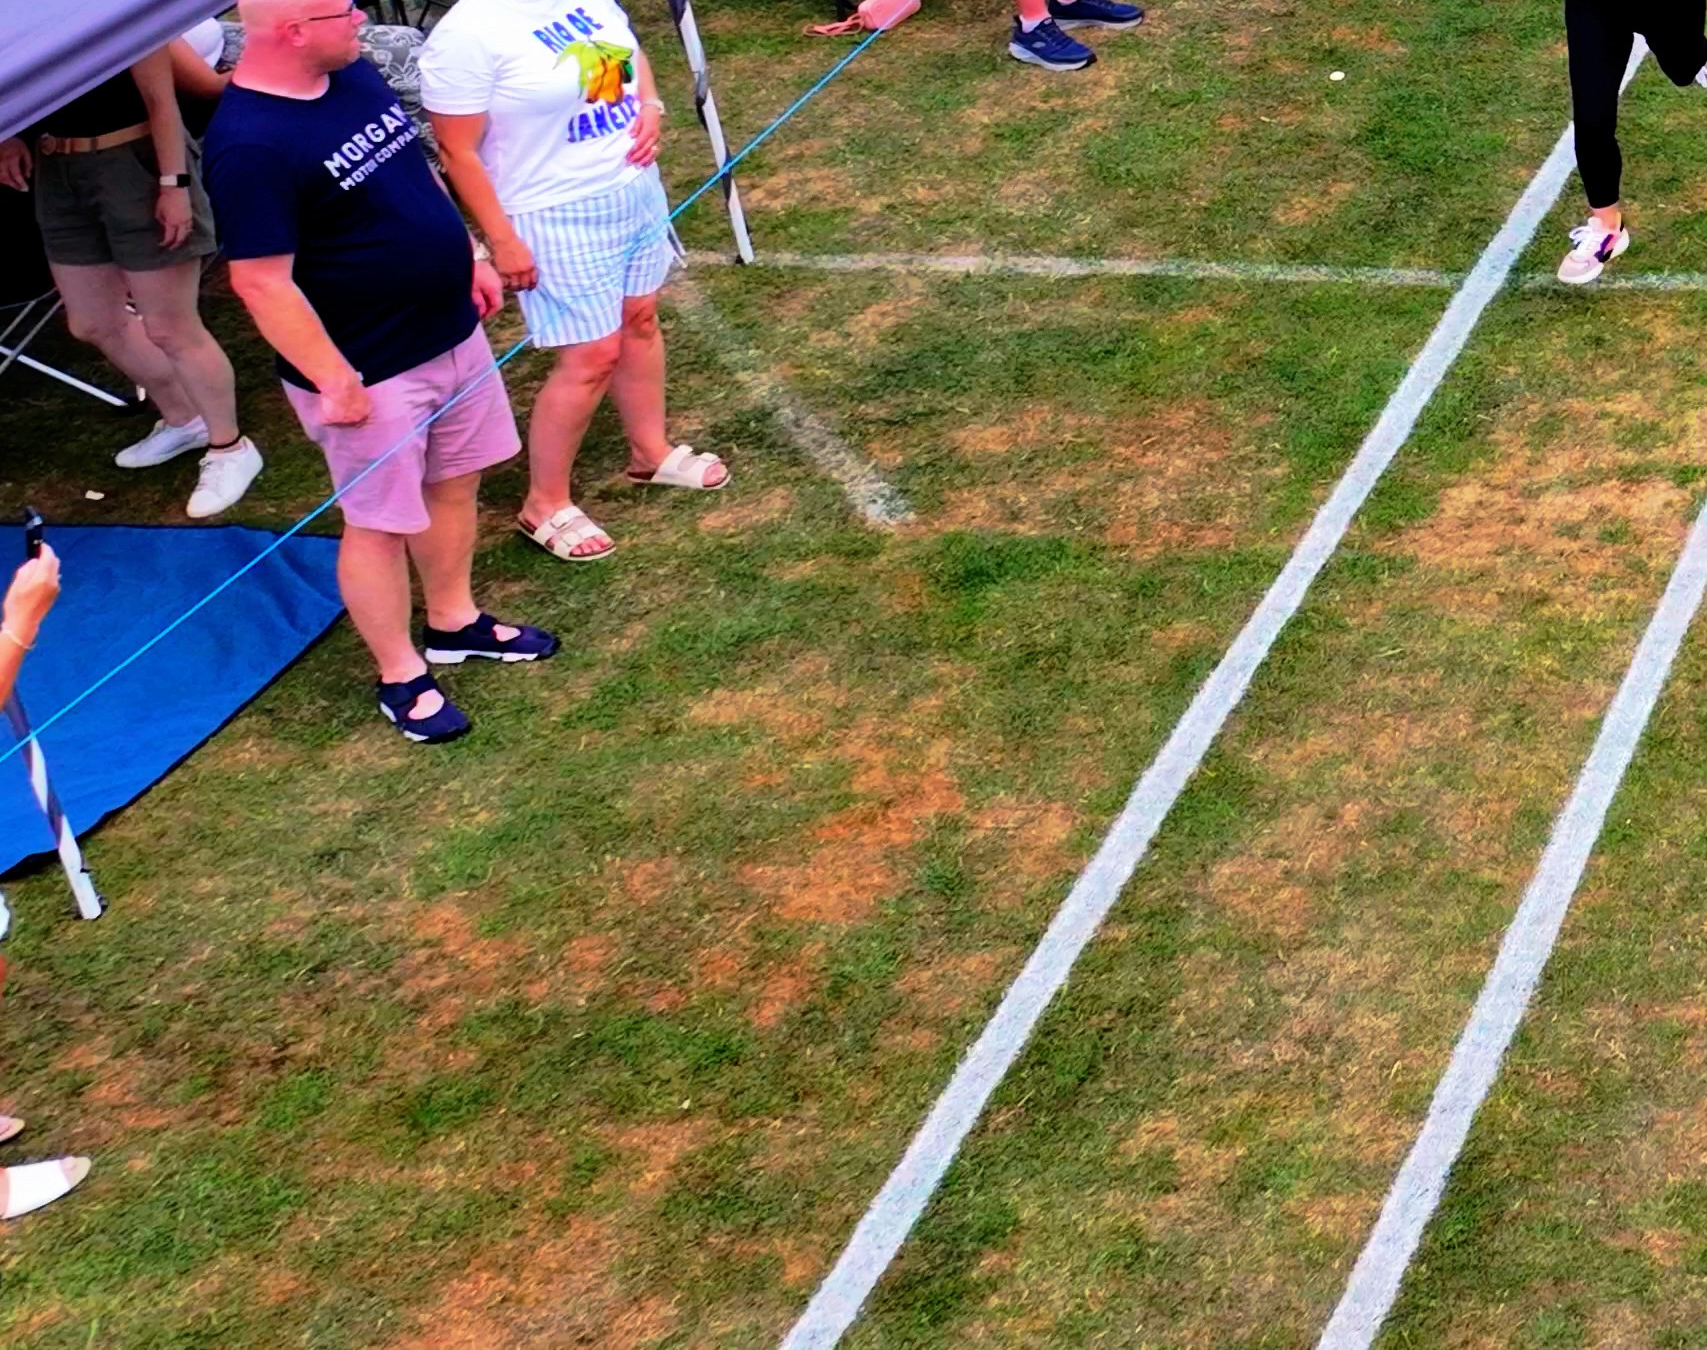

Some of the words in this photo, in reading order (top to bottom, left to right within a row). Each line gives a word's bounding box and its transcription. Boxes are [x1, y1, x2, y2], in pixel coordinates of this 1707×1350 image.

[532, 22, 576, 54] RIO
[323, 103, 407, 177] MORGAN
[339, 159, 379, 190] MOTOR
